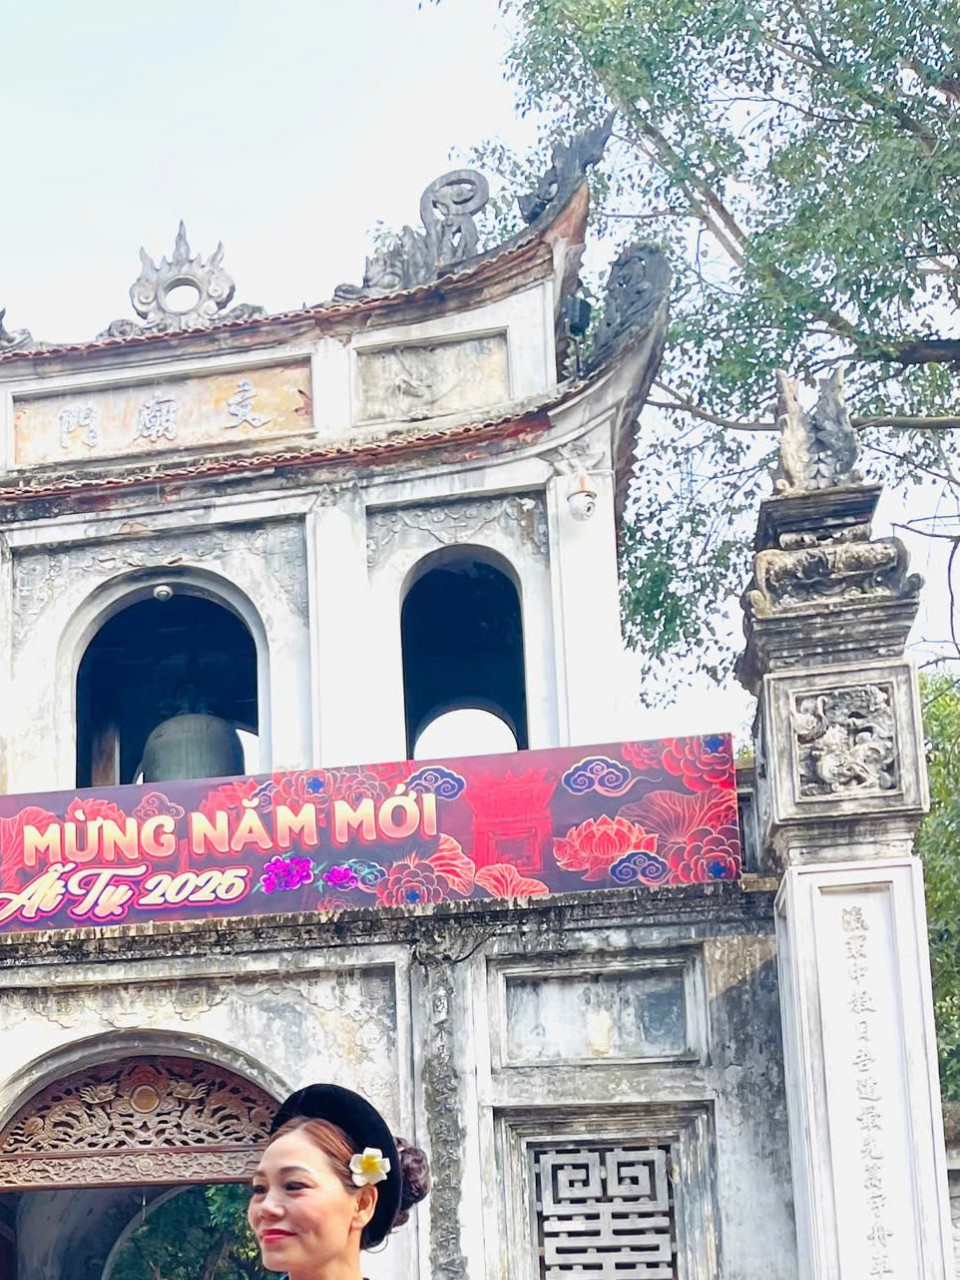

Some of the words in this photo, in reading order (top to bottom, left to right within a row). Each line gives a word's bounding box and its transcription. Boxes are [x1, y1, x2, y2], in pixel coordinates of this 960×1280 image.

[23, 808, 177, 867] MỪNG
[190, 797, 318, 855] NĂM
[334, 783, 438, 844] MỚI
[138, 867, 249, 906] 2025
